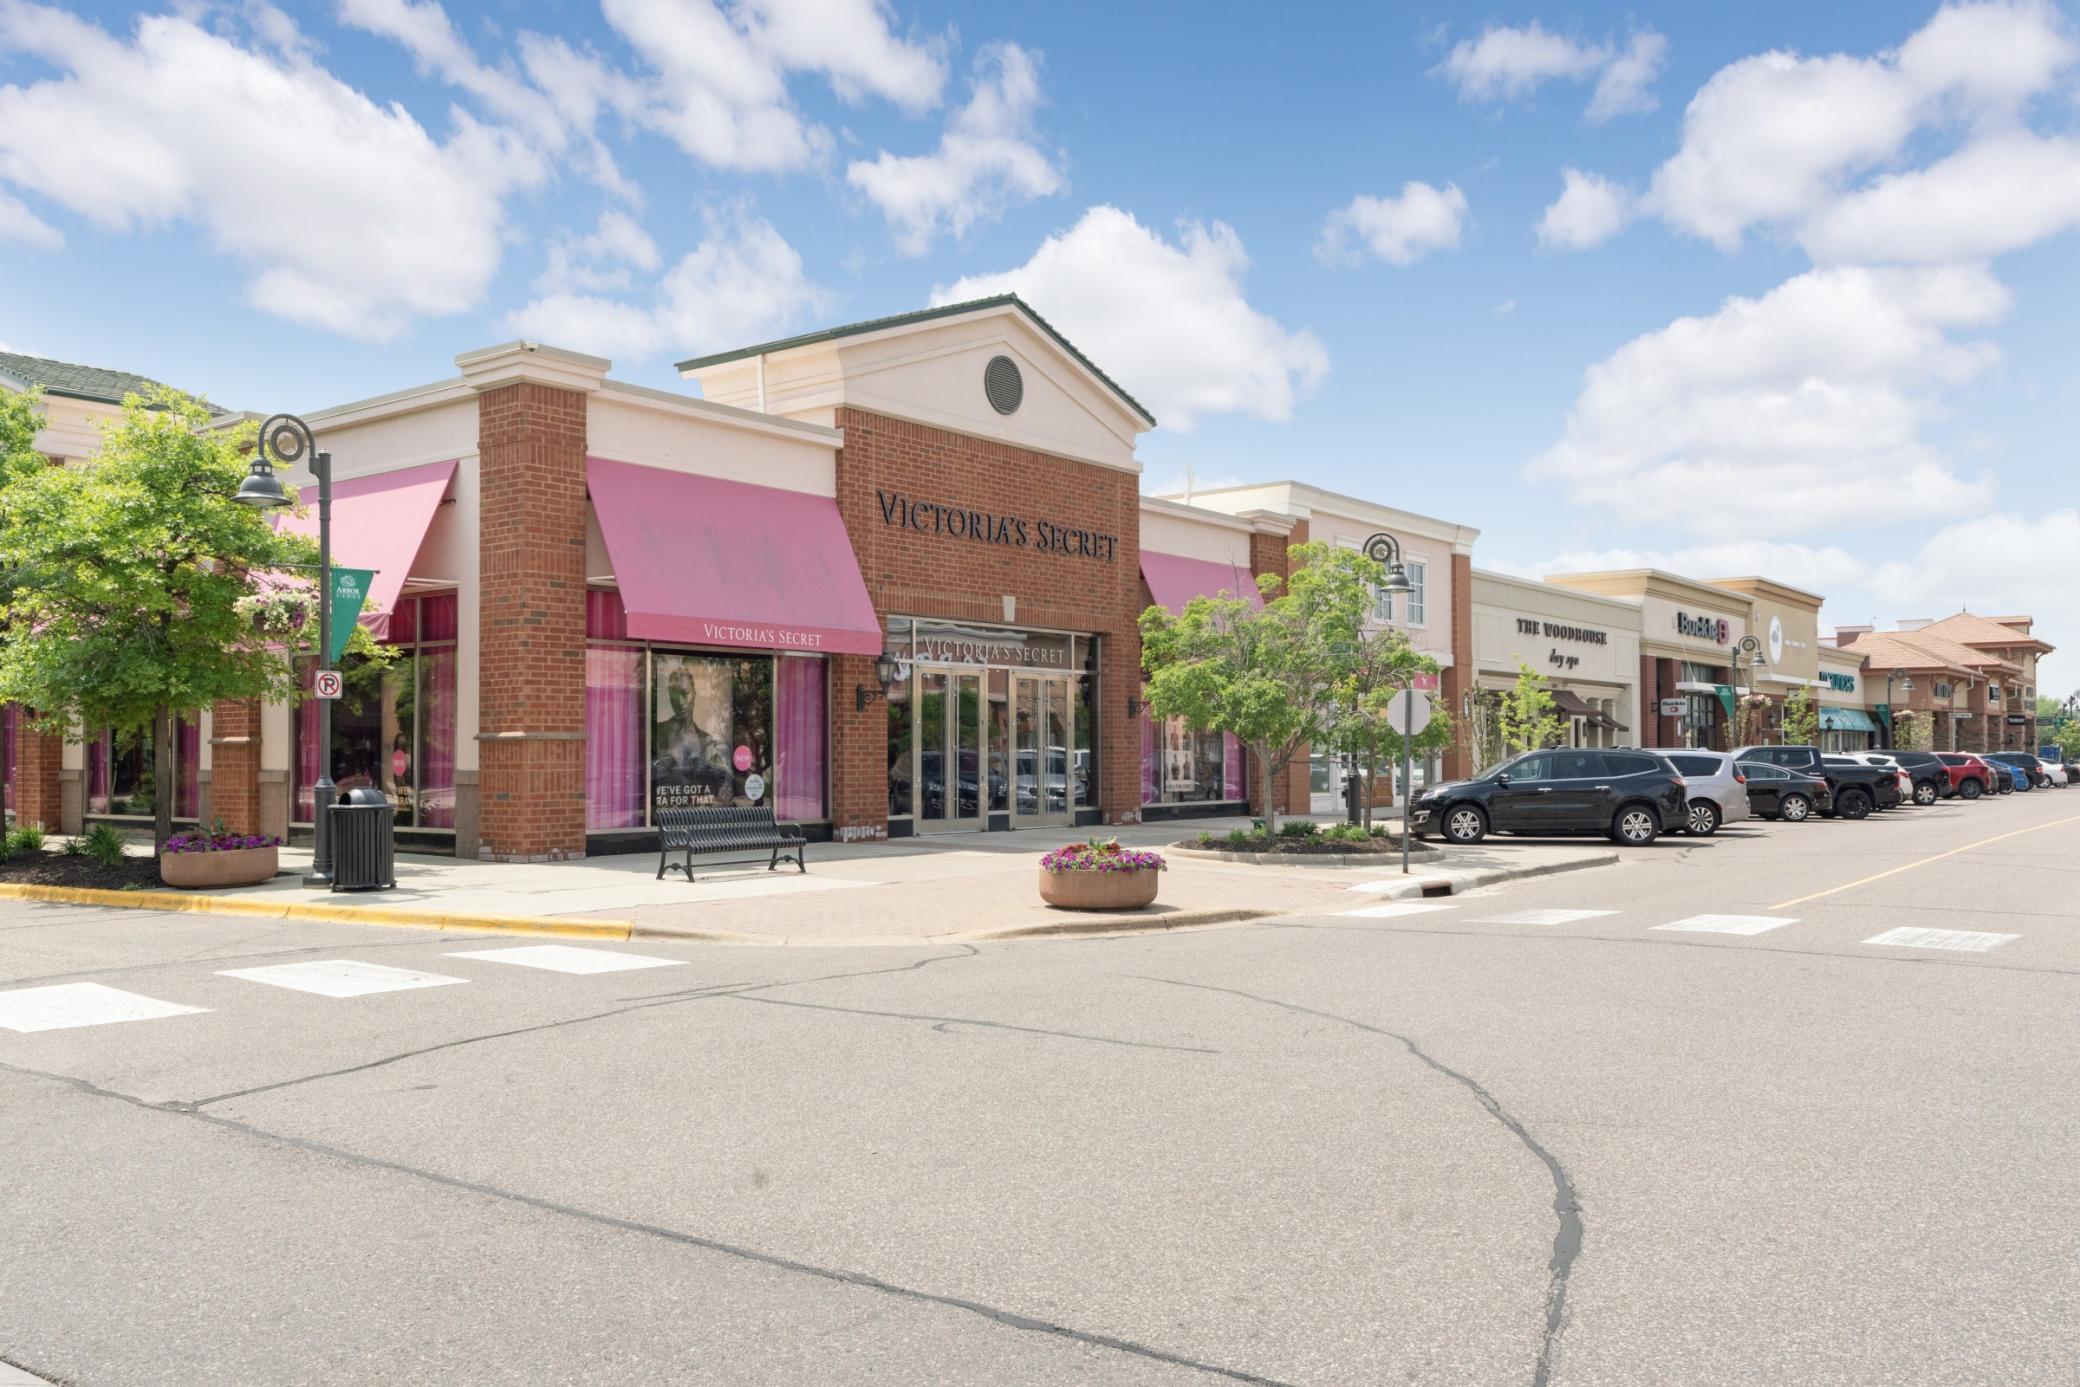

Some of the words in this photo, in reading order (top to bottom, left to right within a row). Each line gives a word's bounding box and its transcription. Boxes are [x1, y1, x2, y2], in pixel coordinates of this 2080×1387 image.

[876, 489, 1028, 547] VICTORIA'S
[1036, 520, 1118, 561] SECRET
[703, 623, 775, 643] VICTORIA'S
[778, 630, 822, 646] SECRET
[1516, 618, 1540, 635] THE
[1543, 622, 1607, 645] WOODHOUSE
[1677, 611, 1718, 641] Buckle
[924, 636, 1010, 660] VICTORIA'S
[1015, 647, 1065, 664] SECRET
[670, 795, 689, 806] FOR
[690, 794, 715, 805] THAT
[683, 784, 702, 794] GOT
[704, 784, 711, 794] A
